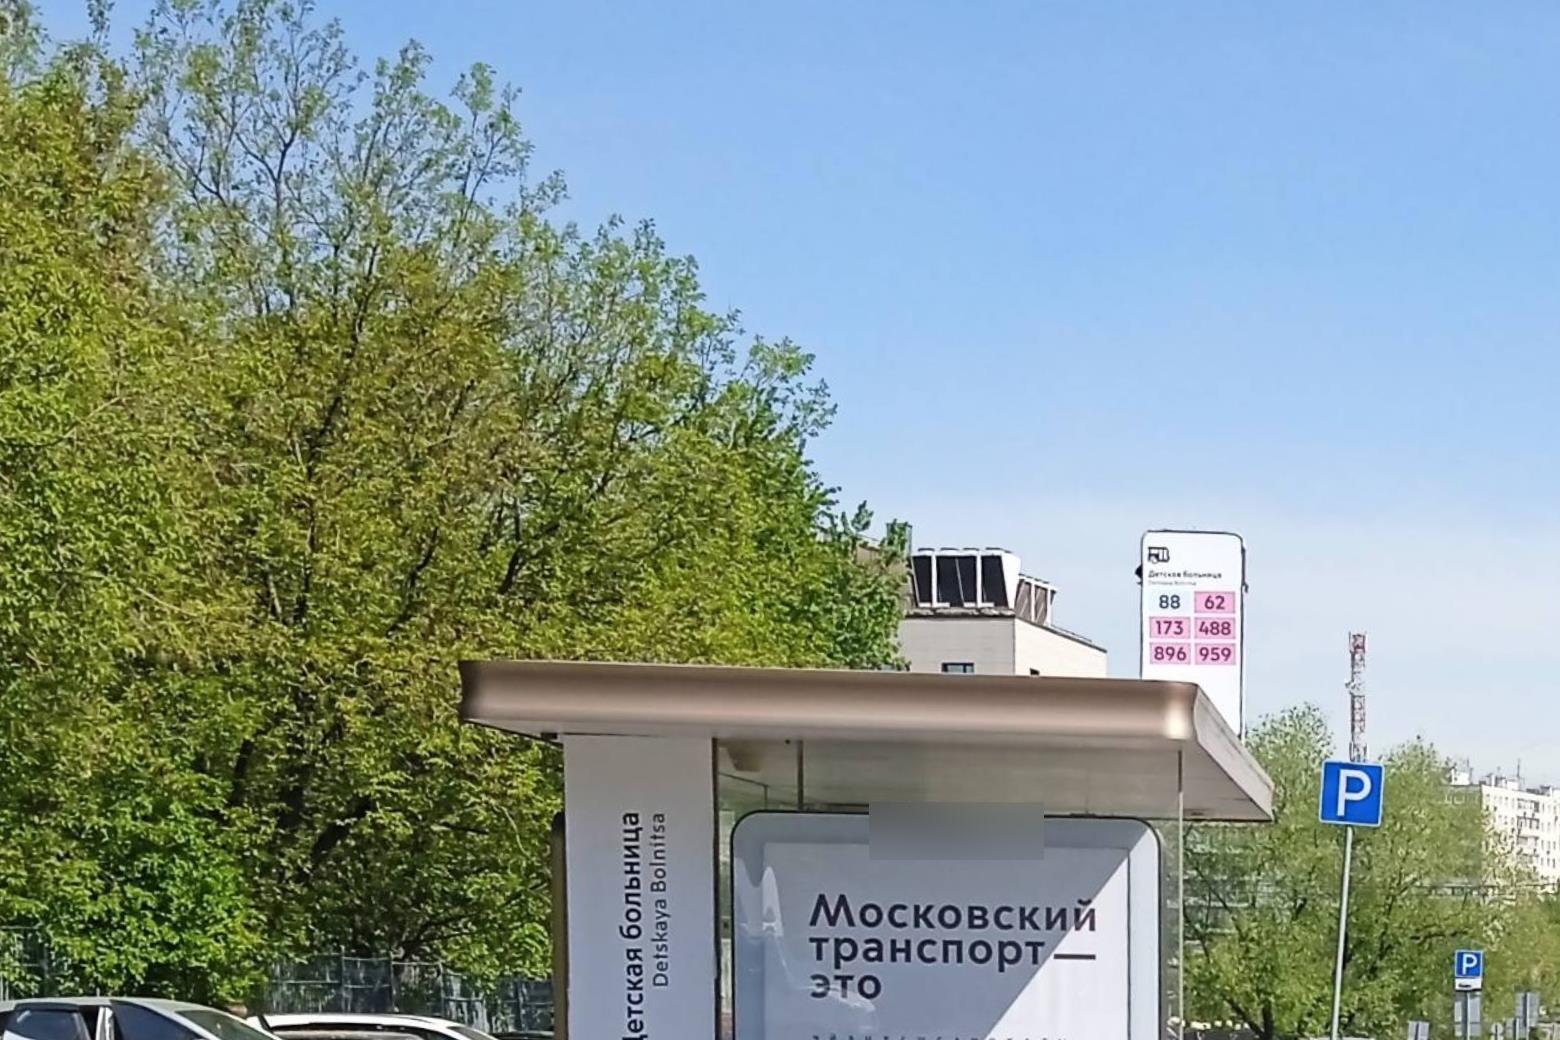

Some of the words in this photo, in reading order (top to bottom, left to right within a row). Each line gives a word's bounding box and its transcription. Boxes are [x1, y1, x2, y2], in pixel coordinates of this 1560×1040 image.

[1158, 595, 1181, 609] 88
[1204, 595, 1225, 609] 62
[1156, 621, 1184, 635] 173
[1199, 621, 1231, 635] 488
[1154, 646, 1187, 661] 896
[1199, 647, 1231, 661] 959
[1337, 769, 1371, 816] P
[649, 813, 667, 892] Bolnitsa
[619, 812, 643, 939] больница
[809, 894, 1096, 931] Московский
[651, 898, 671, 987] Detskaya
[809, 936, 1045, 972] транспорт
[1463, 954, 1477, 975] P
[810, 974, 882, 1000] это
